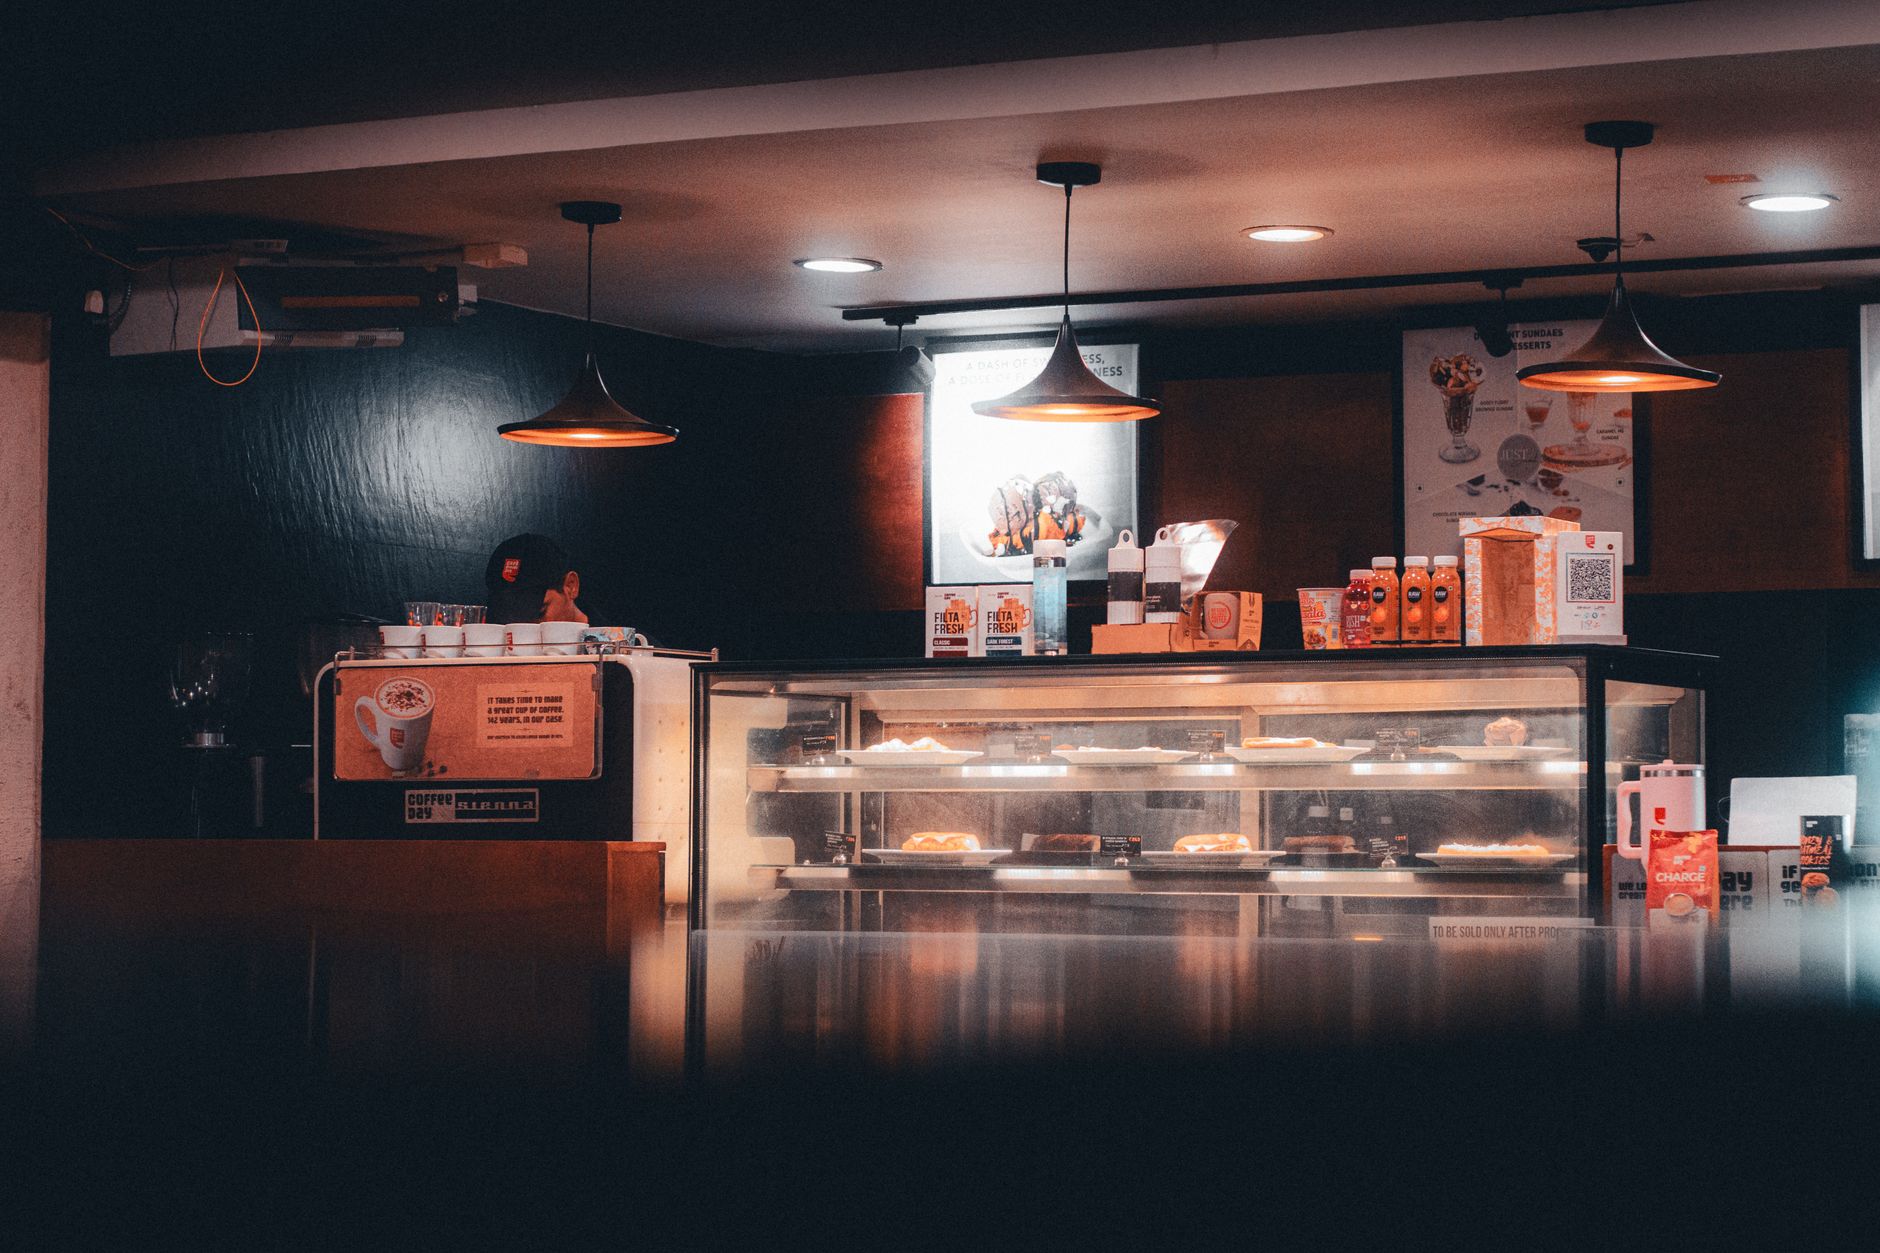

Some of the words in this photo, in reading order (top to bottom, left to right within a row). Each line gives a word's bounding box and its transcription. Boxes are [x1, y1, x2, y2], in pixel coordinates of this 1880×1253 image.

[1521, 328, 1564, 338] SUNDAES
[1513, 341, 1552, 350] ESSERTS
[977, 360, 1009, 371] DASH
[1013, 358, 1027, 369] OF
[934, 612, 959, 623] FILTA
[987, 611, 1013, 621] FILTA
[934, 623, 964, 634] FRESH
[987, 623, 1018, 633] FRESH
[487, 716, 498, 724] 142
[1655, 871, 1706, 883] CHARGE
[1432, 925, 1444, 938] TO
[1446, 925, 1457, 938] BE
[1459, 925, 1482, 938] SOLD
[1483, 925, 1506, 938] ONLY
[1508, 925, 1536, 938] AFTER
